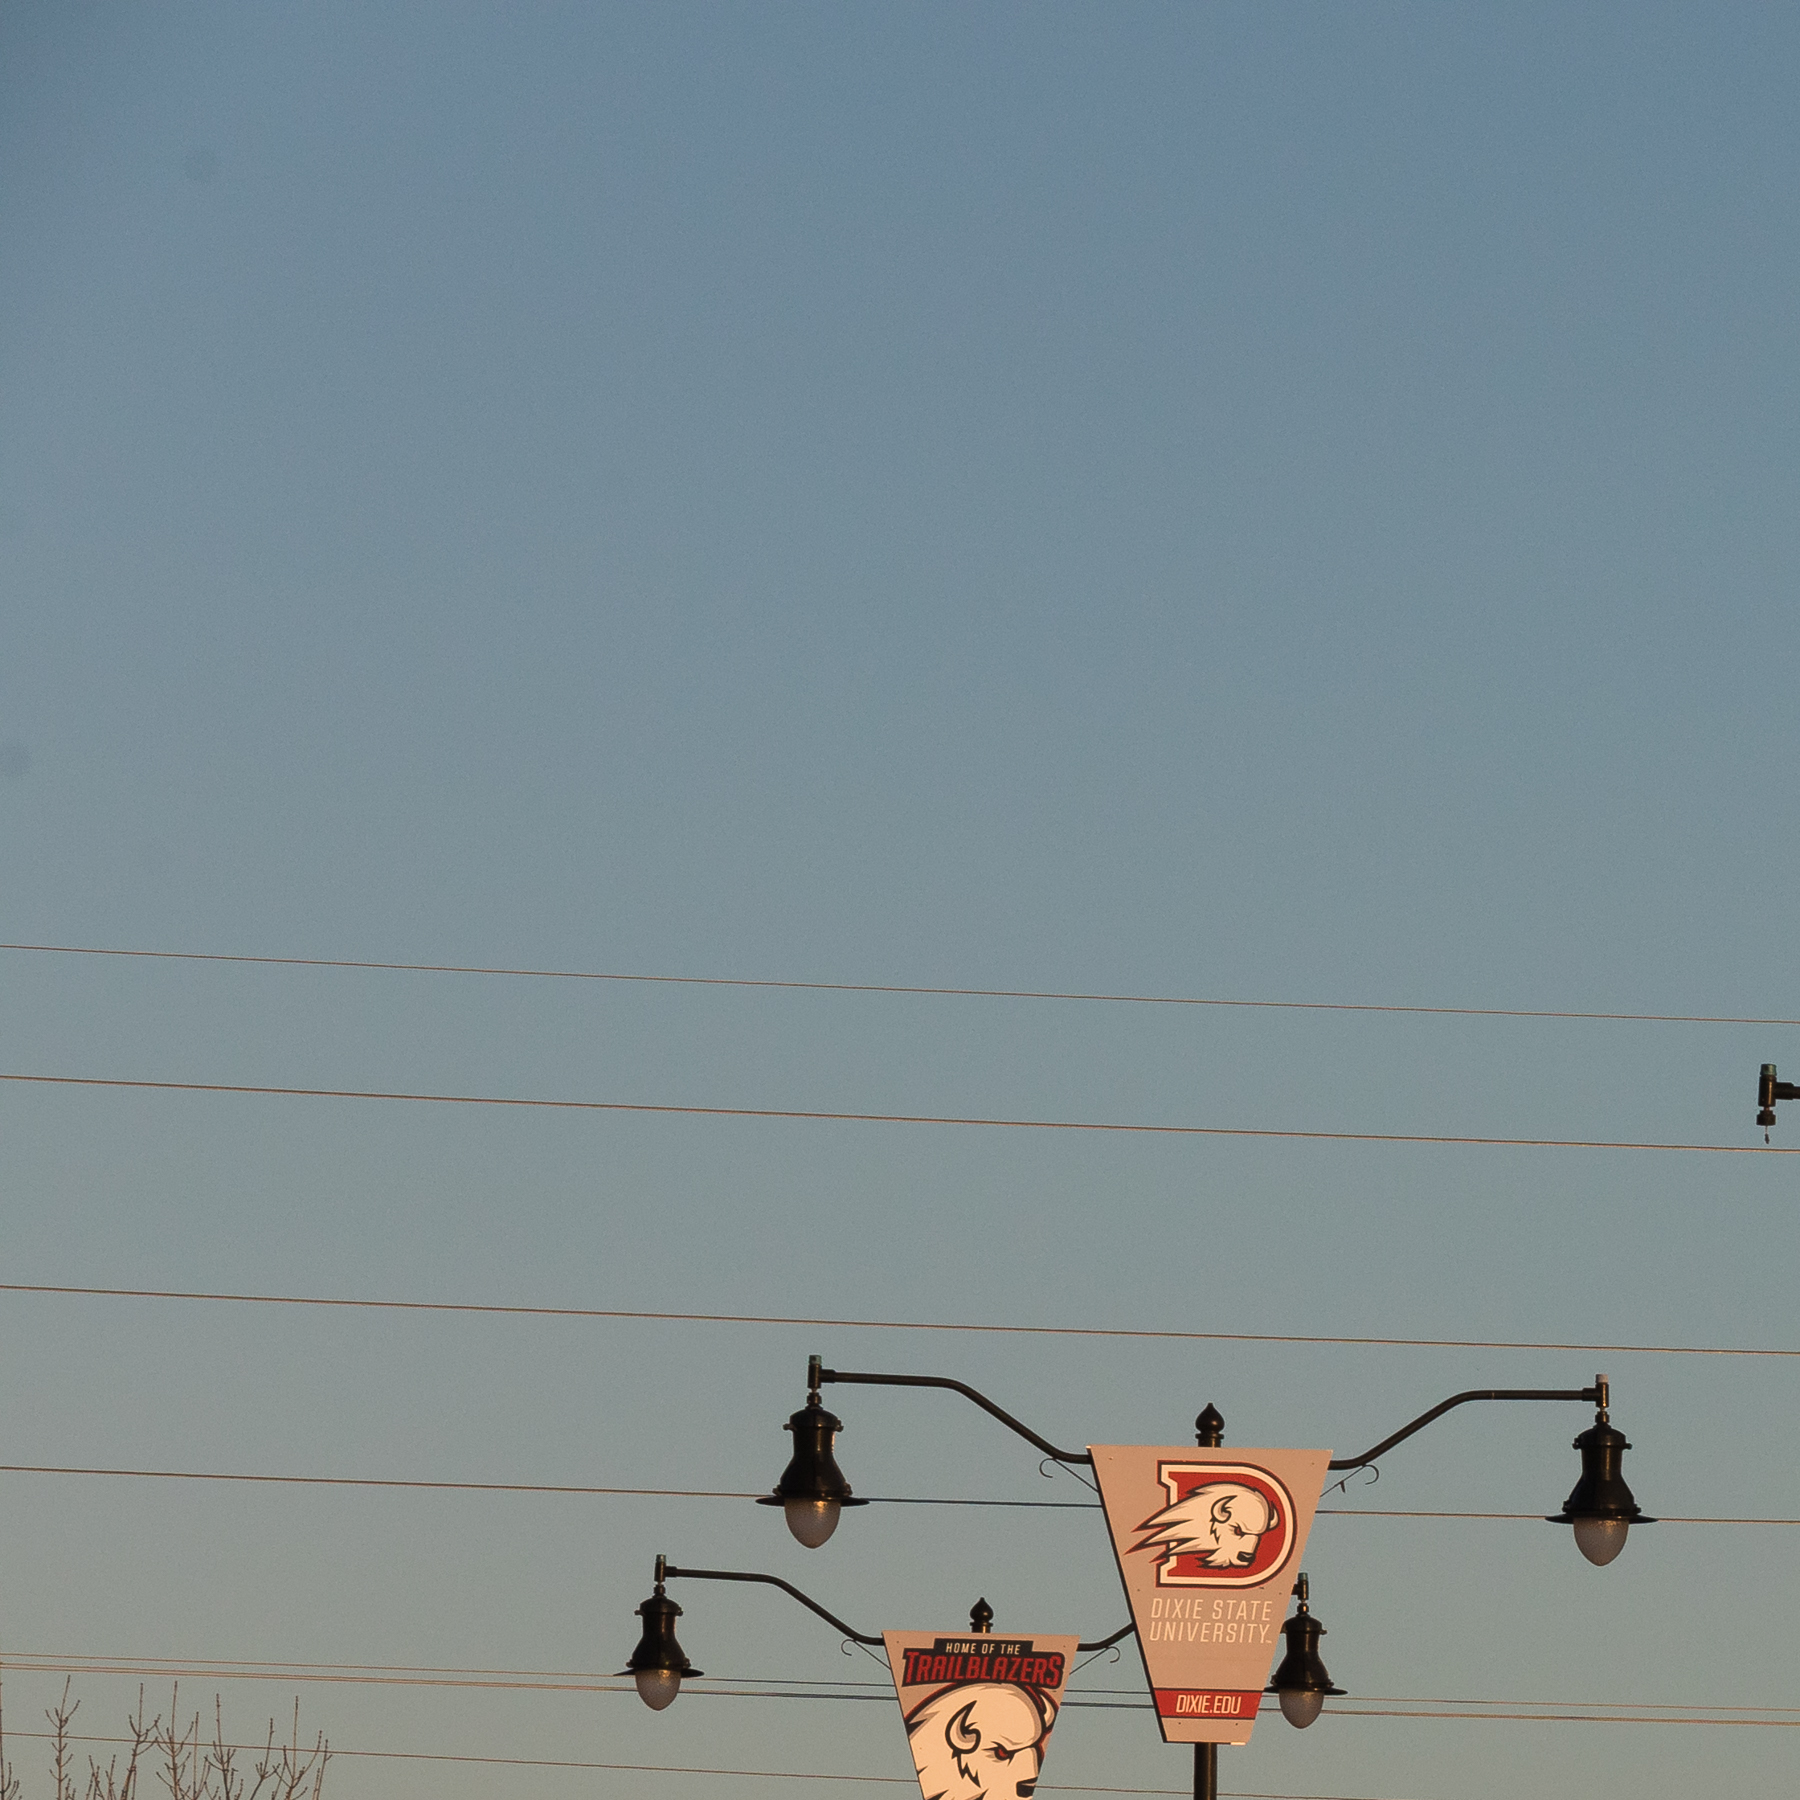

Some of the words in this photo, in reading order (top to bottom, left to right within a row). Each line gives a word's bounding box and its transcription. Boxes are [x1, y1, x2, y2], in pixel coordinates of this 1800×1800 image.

[1151, 1598, 1203, 1619] DIXIE
[1212, 1600, 1273, 1621] STATE
[1149, 1621, 1271, 1643] UNIVERSITY
[946, 1642, 977, 1654] HOME
[981, 1643, 995, 1654] OF
[1000, 1644, 1021, 1655] THE
[904, 1651, 1062, 1688] TRAILBLAZERS
[1175, 1694, 1241, 1714] DIXIE.EDU
